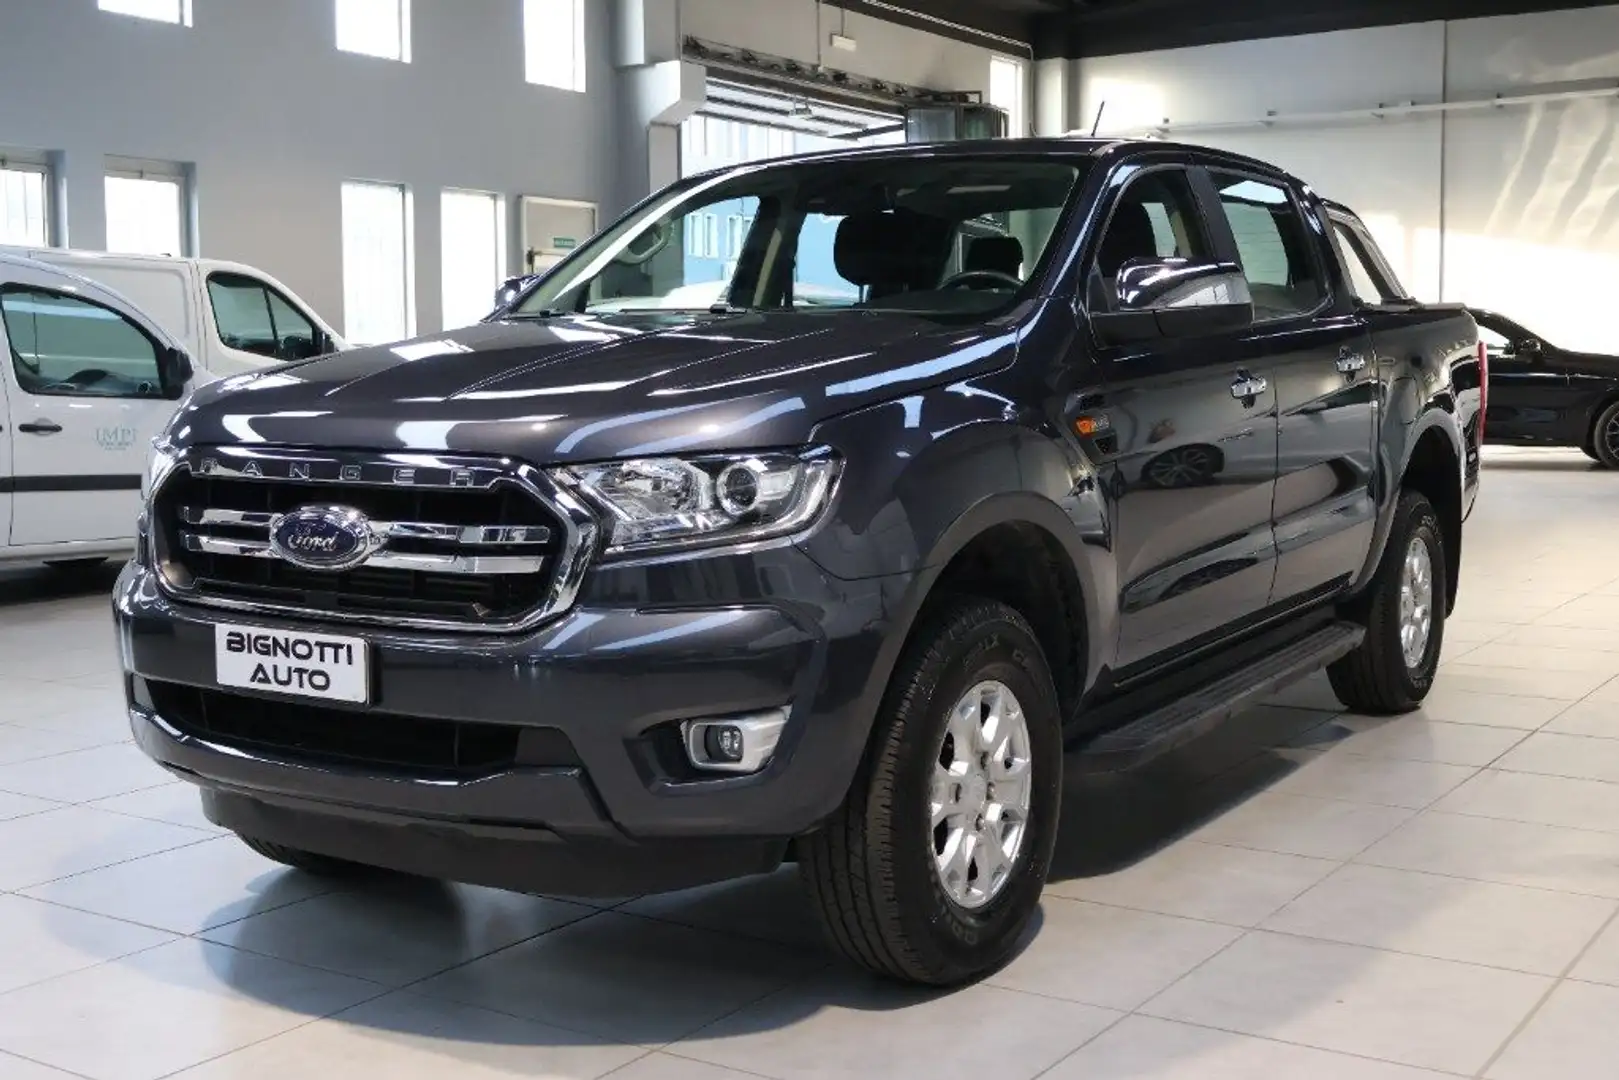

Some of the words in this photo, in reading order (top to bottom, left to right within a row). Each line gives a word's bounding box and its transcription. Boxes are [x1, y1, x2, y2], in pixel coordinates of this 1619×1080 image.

[199, 457, 476, 486] RANGER
[287, 523, 340, 552] Ford
[226, 631, 353, 666] BIGNOTTI
[250, 663, 331, 692] AUTO
